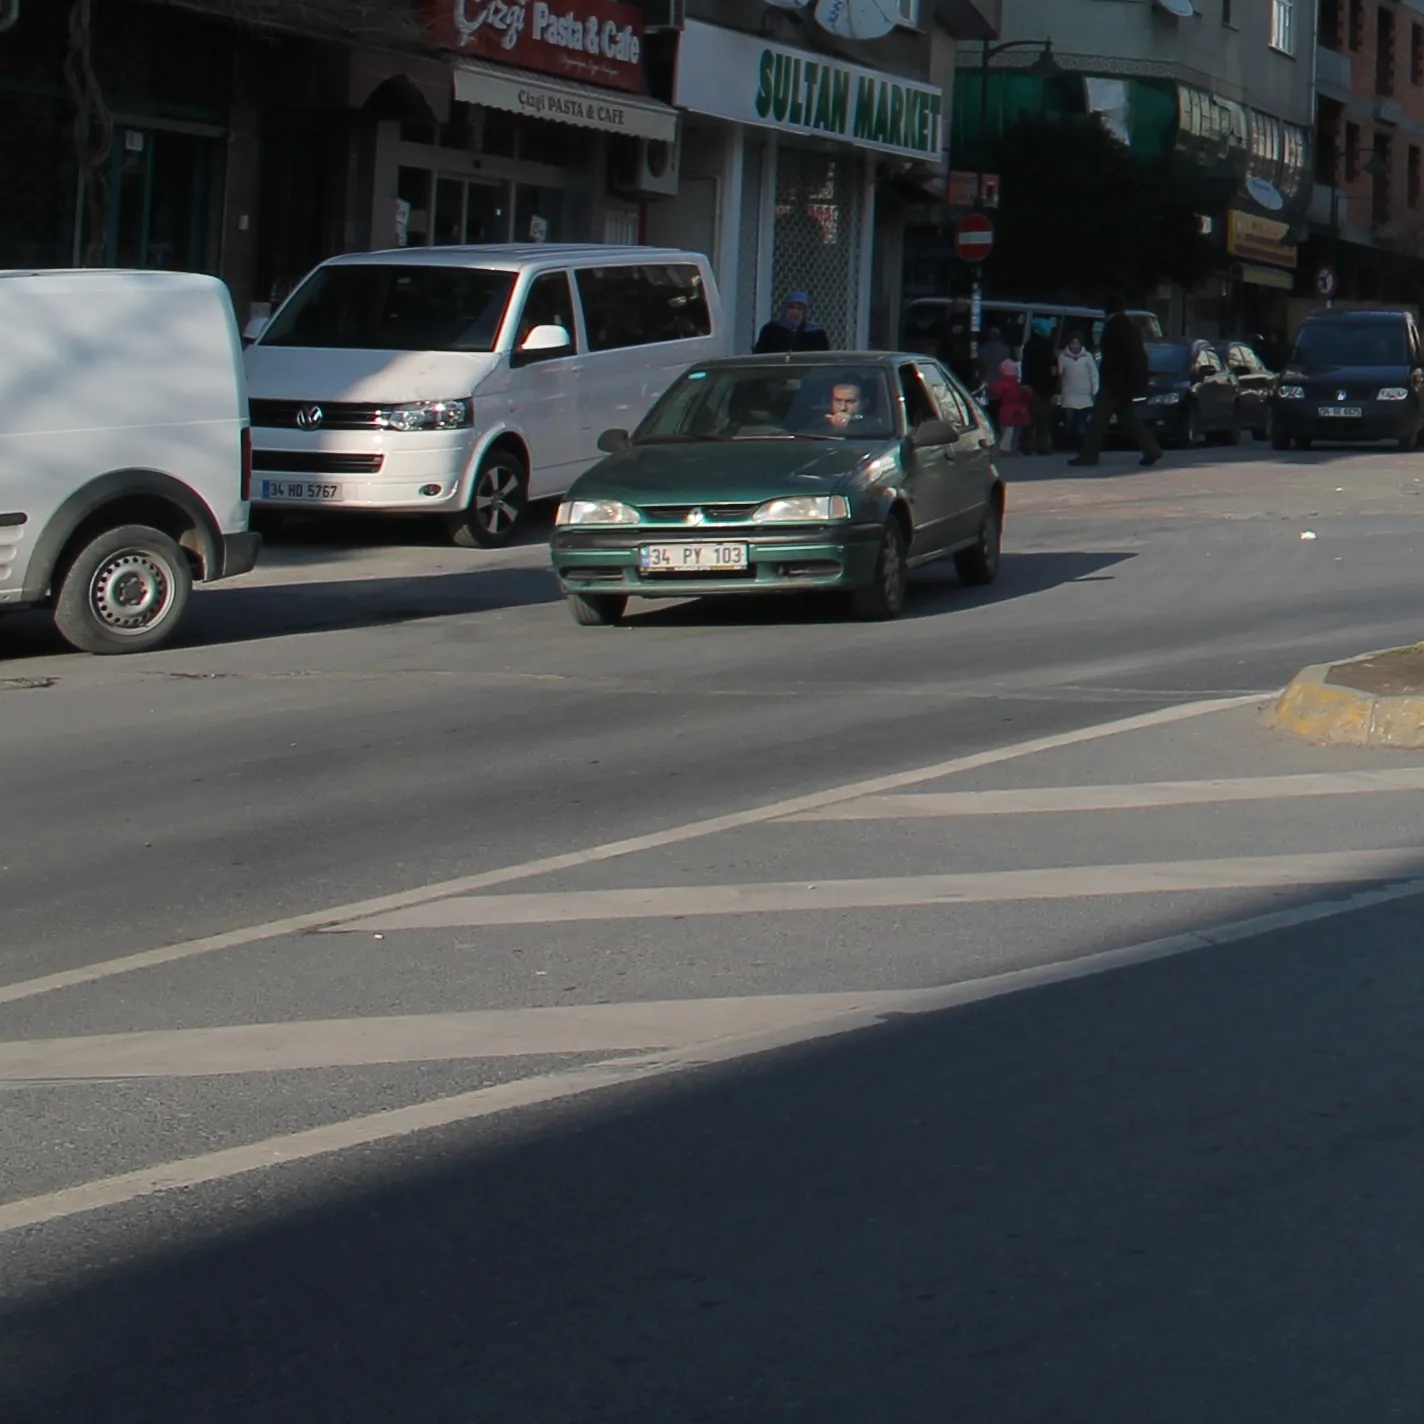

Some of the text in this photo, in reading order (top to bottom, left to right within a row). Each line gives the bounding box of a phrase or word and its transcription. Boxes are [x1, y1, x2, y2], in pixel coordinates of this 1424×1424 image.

[532, 1, 584, 53] Pasta
[584, 14, 600, 55] &
[600, 19, 640, 64] Cafe
[518, 90, 625, 125] Çizgi PASTA & CAFE
[755, 48, 942, 154] SULTAN MARKET
[270, 483, 338, 498] 34 HD 5767
[651, 547, 743, 565] 34 PY 103
